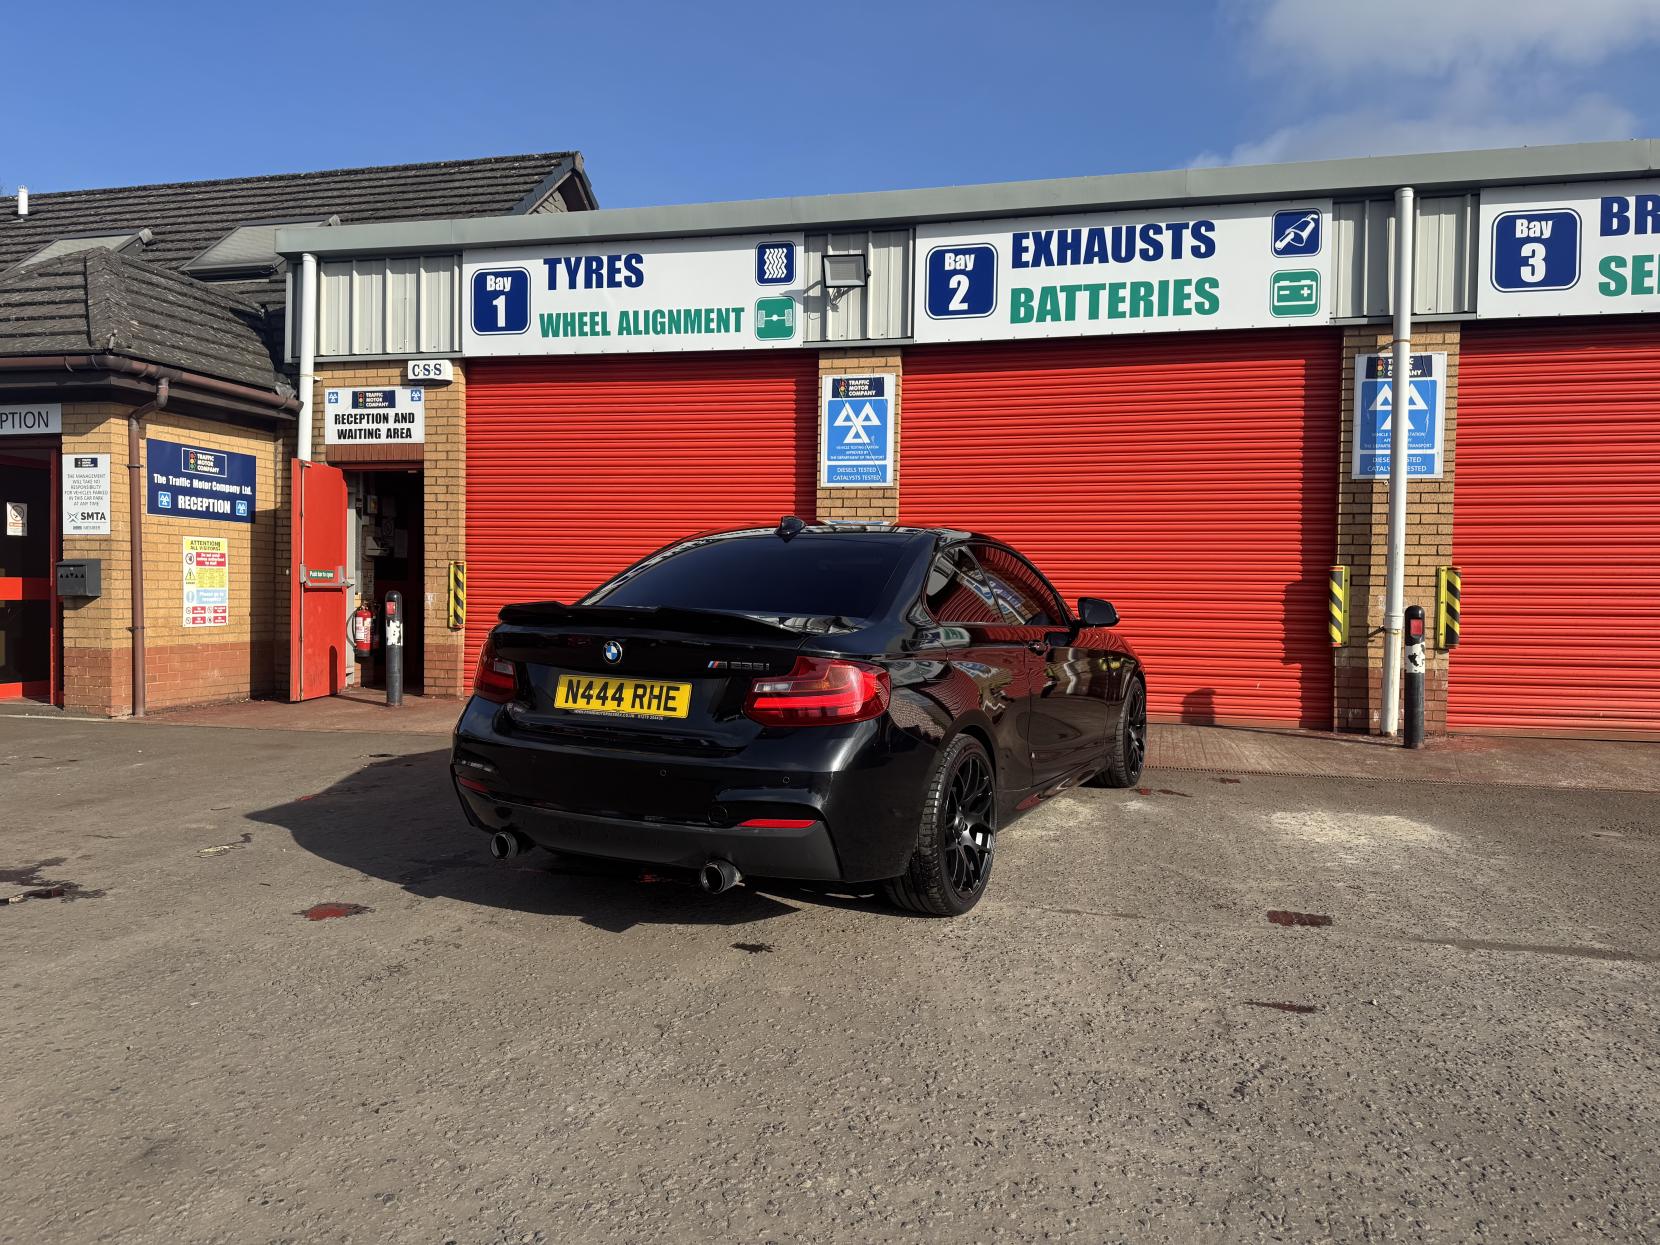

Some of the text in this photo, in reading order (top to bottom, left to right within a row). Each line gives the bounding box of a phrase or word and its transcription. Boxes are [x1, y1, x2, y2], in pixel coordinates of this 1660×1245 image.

[1515, 219, 1553, 239] Bay
[1011, 220, 1216, 269] EXHAUSTS
[543, 253, 644, 291] TYRES
[944, 252, 975, 271] Bay
[1520, 242, 1546, 283] 3
[486, 275, 512, 292] Bay
[1598, 253, 1660, 297] SE
[948, 274, 970, 311] 2
[1010, 277, 1220, 324] BATTERIES
[492, 295, 506, 328] 1
[539, 307, 745, 338] WHEEL ALIGNMENT
[334, 412, 415, 425] RECEPTION AND
[337, 427, 412, 440] WAITING AREA
[197, 453, 215, 462] TRAFFIC
[197, 459, 214, 467] MOTOR
[197, 464, 219, 473] COMPANY
[153, 473, 252, 495] The Traffic Motor Company Ltd.
[178, 495, 231, 513] RECEPTION
[81, 512, 106, 521] SMTA
[564, 679, 680, 712] N444 RHE
